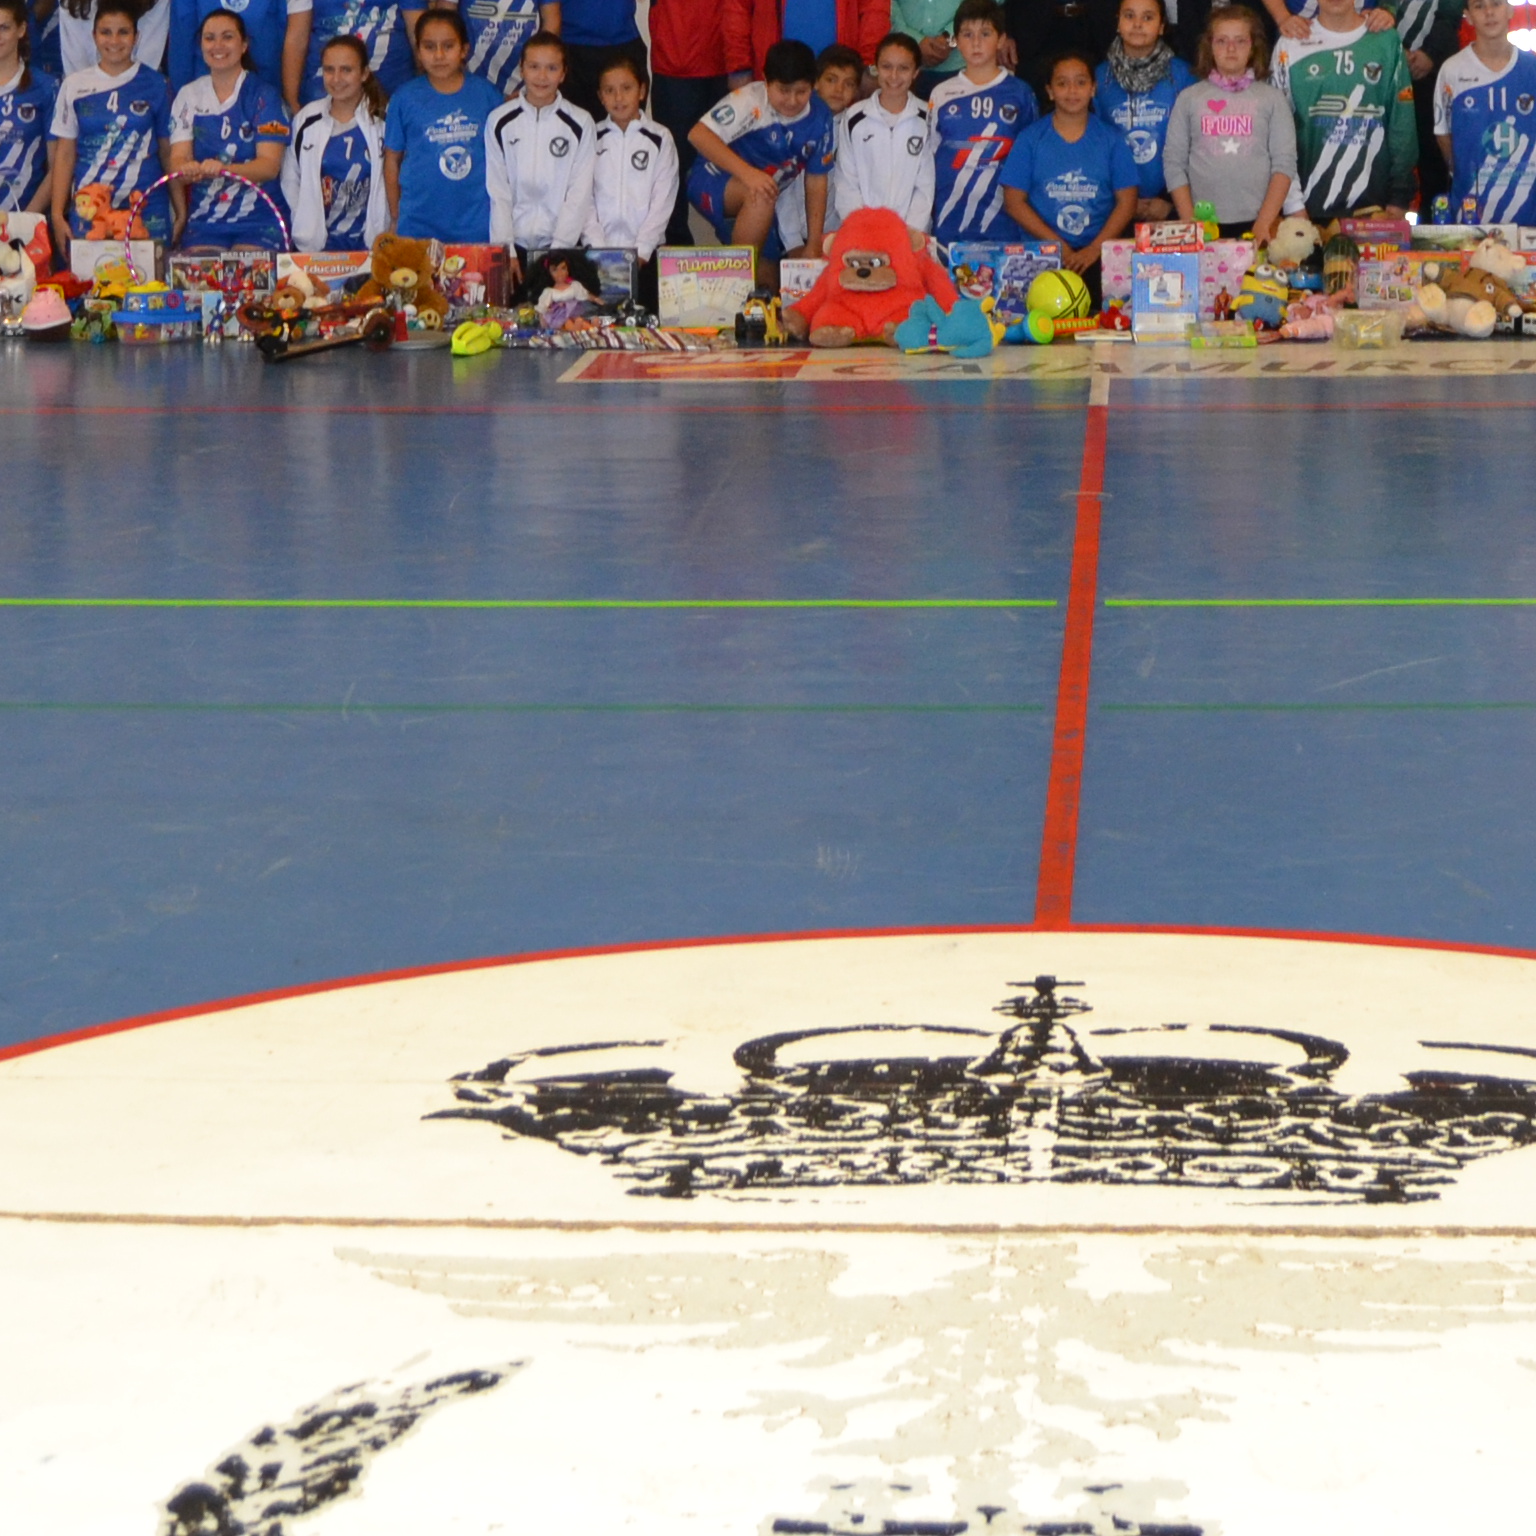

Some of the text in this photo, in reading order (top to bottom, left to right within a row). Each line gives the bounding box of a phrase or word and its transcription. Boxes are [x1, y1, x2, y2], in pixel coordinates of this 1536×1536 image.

[1332, 50, 1356, 76] 75
[106, 92, 119, 114] 4
[970, 96, 994, 120] 99
[1487, 85, 1509, 112] 11
[1201, 114, 1253, 137] FUN
